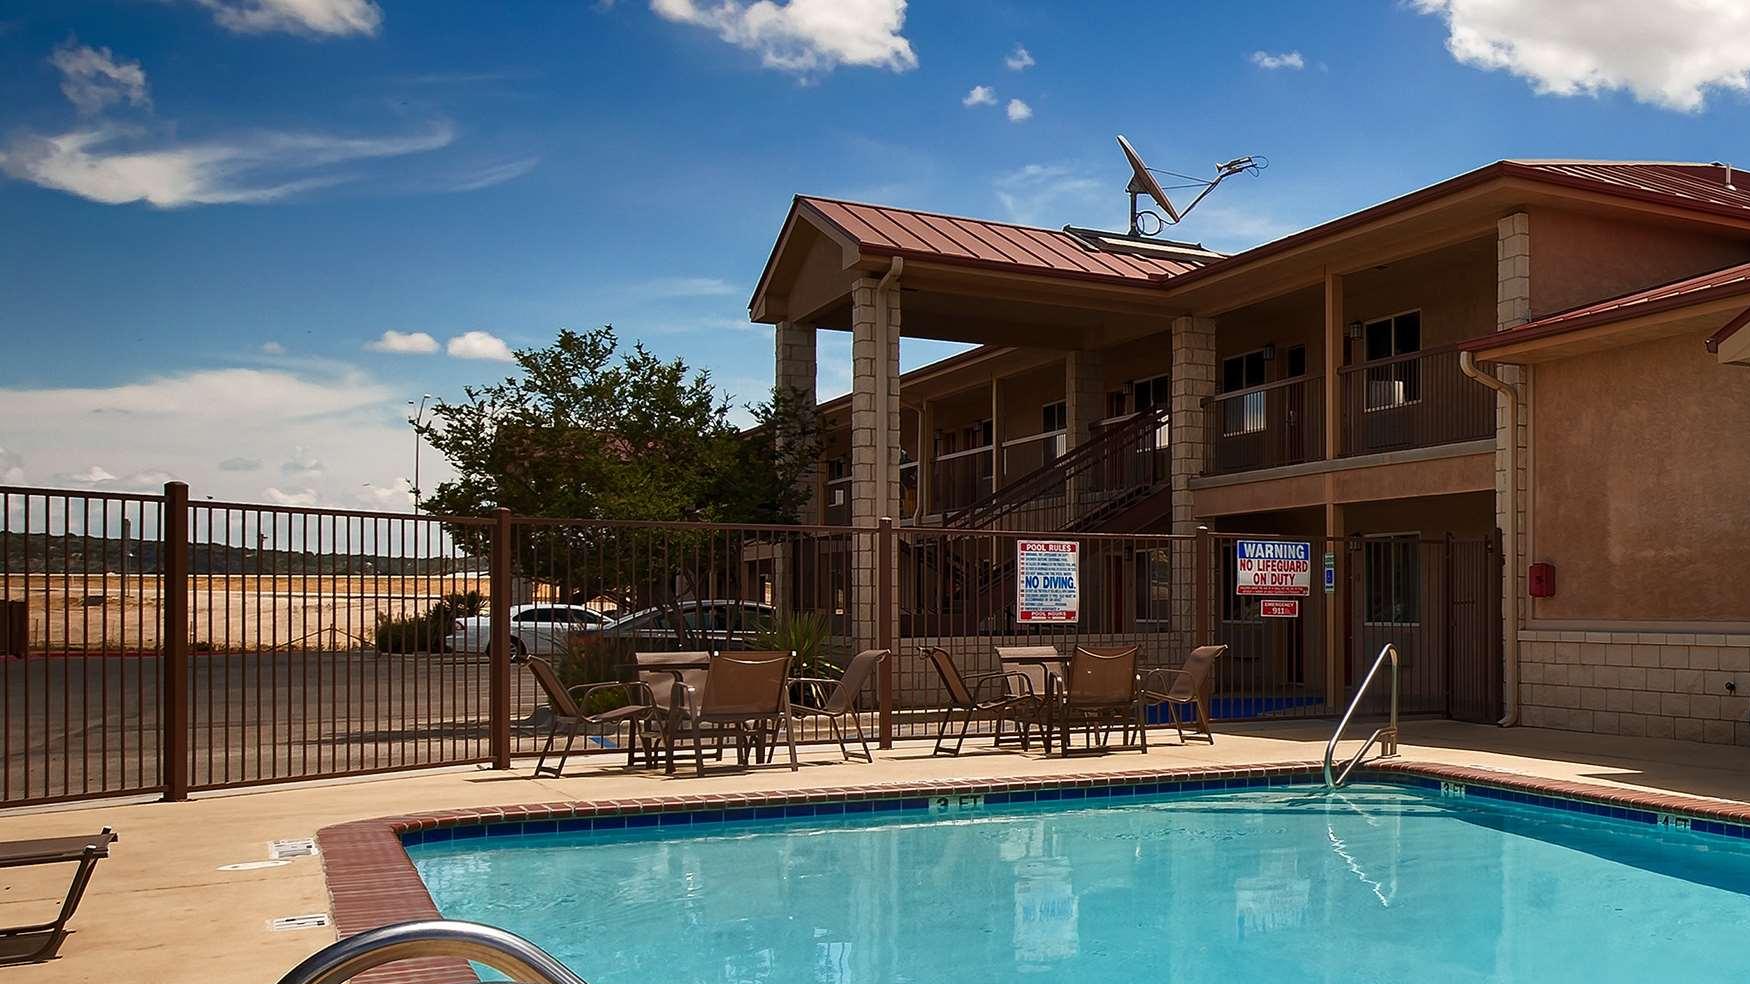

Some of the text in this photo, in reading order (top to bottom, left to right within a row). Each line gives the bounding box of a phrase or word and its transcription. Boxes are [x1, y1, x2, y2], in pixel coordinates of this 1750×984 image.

[1243, 543, 1305, 559] WARNING
[1239, 559, 1308, 572] NO LIFEGUARD
[1025, 575, 1039, 589] NO
[1253, 573, 1296, 585] ON DUTY
